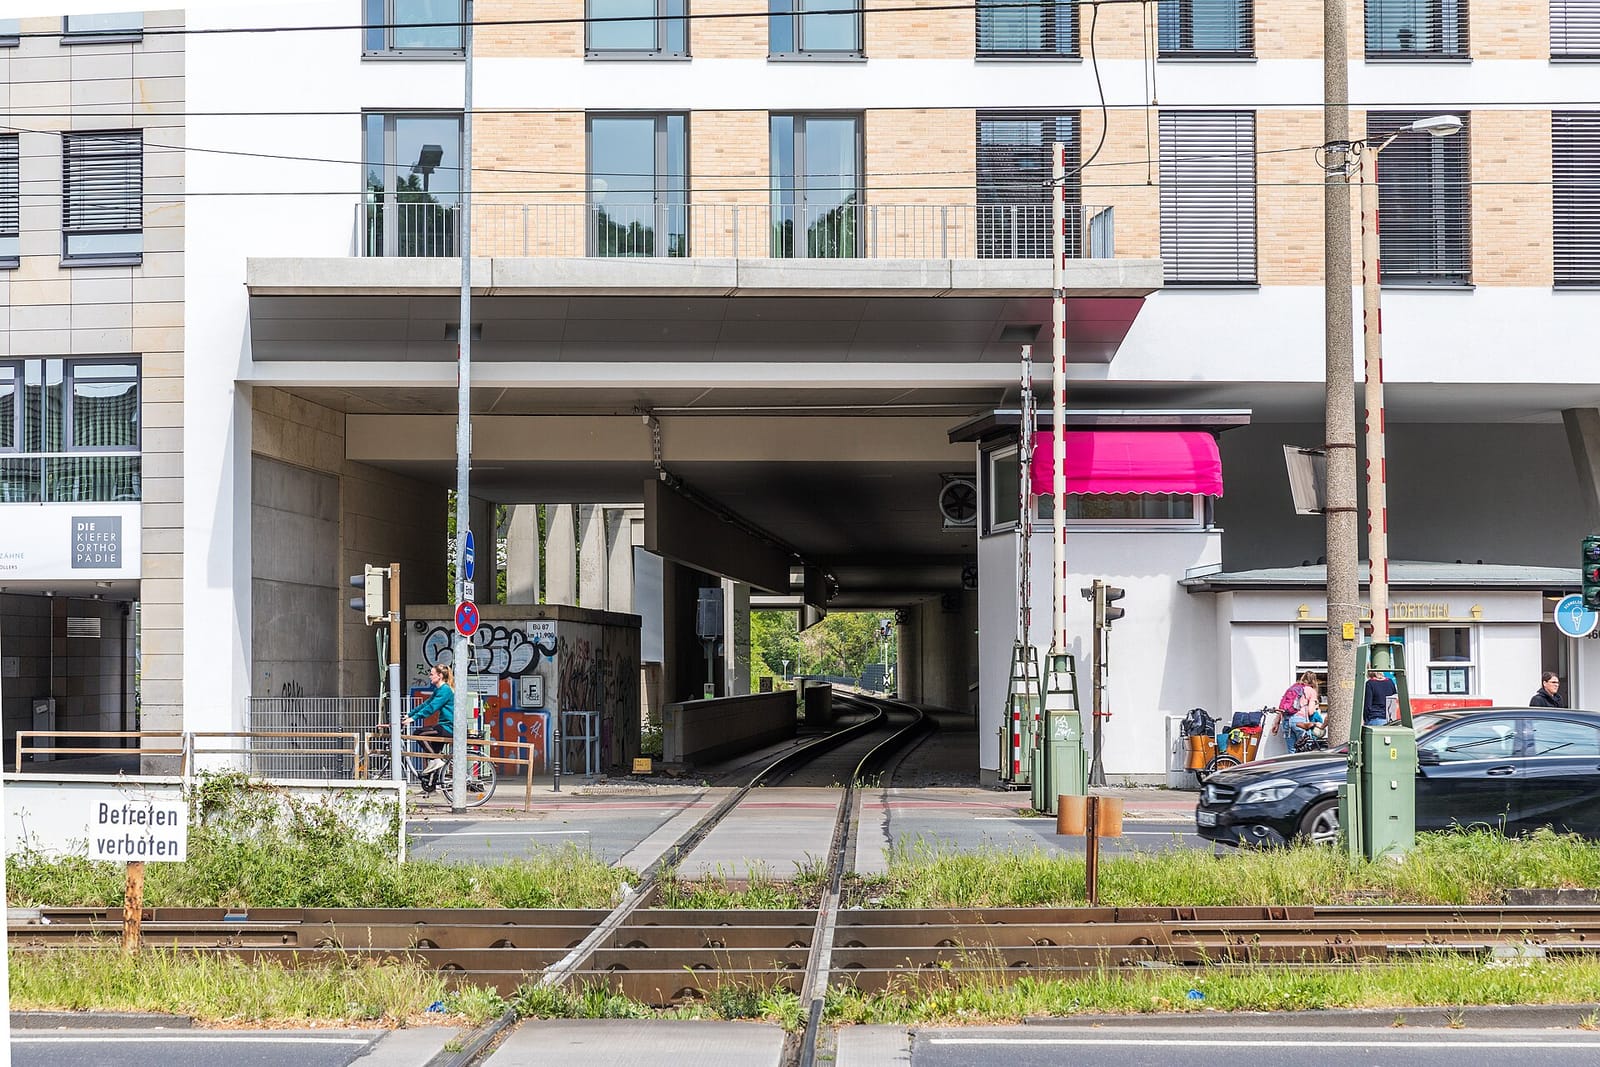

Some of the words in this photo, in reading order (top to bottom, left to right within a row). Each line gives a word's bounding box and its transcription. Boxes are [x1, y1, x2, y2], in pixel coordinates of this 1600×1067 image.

[77, 522, 96, 531] DIE
[77, 532, 117, 542] KIEFER
[76, 543, 117, 552] ORTHO
[77, 553, 116, 563] PÄDIE
[1392, 602, 1449, 618] TÖRTCHEN
[98, 802, 178, 826] Betreten
[97, 833, 178, 856] verboten
